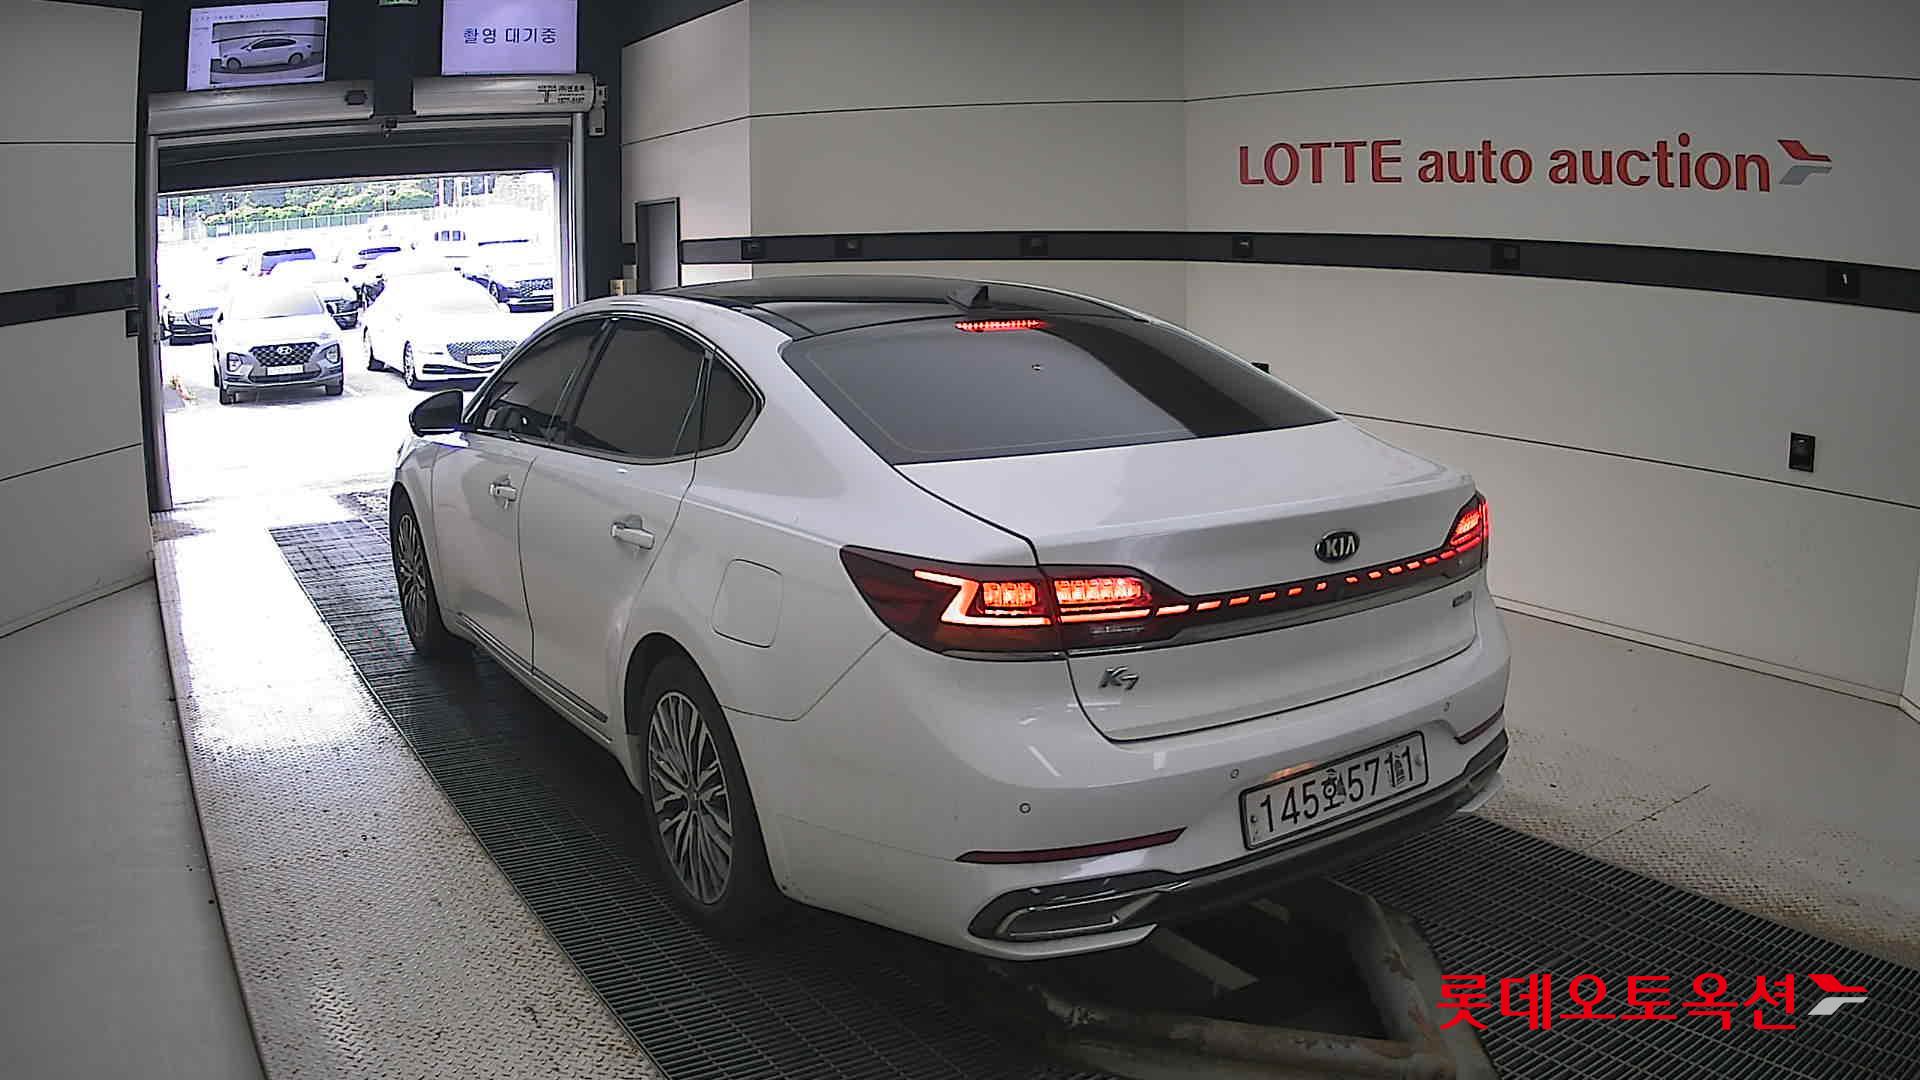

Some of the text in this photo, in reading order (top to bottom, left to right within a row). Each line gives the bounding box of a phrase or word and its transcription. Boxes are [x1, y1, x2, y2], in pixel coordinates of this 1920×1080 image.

[463, 27, 557, 44] 촬영 대기중
[1239, 132, 1771, 192] LOTTE auto auction
[1325, 535, 1356, 558] KIA
[1098, 665, 1140, 690] K7
